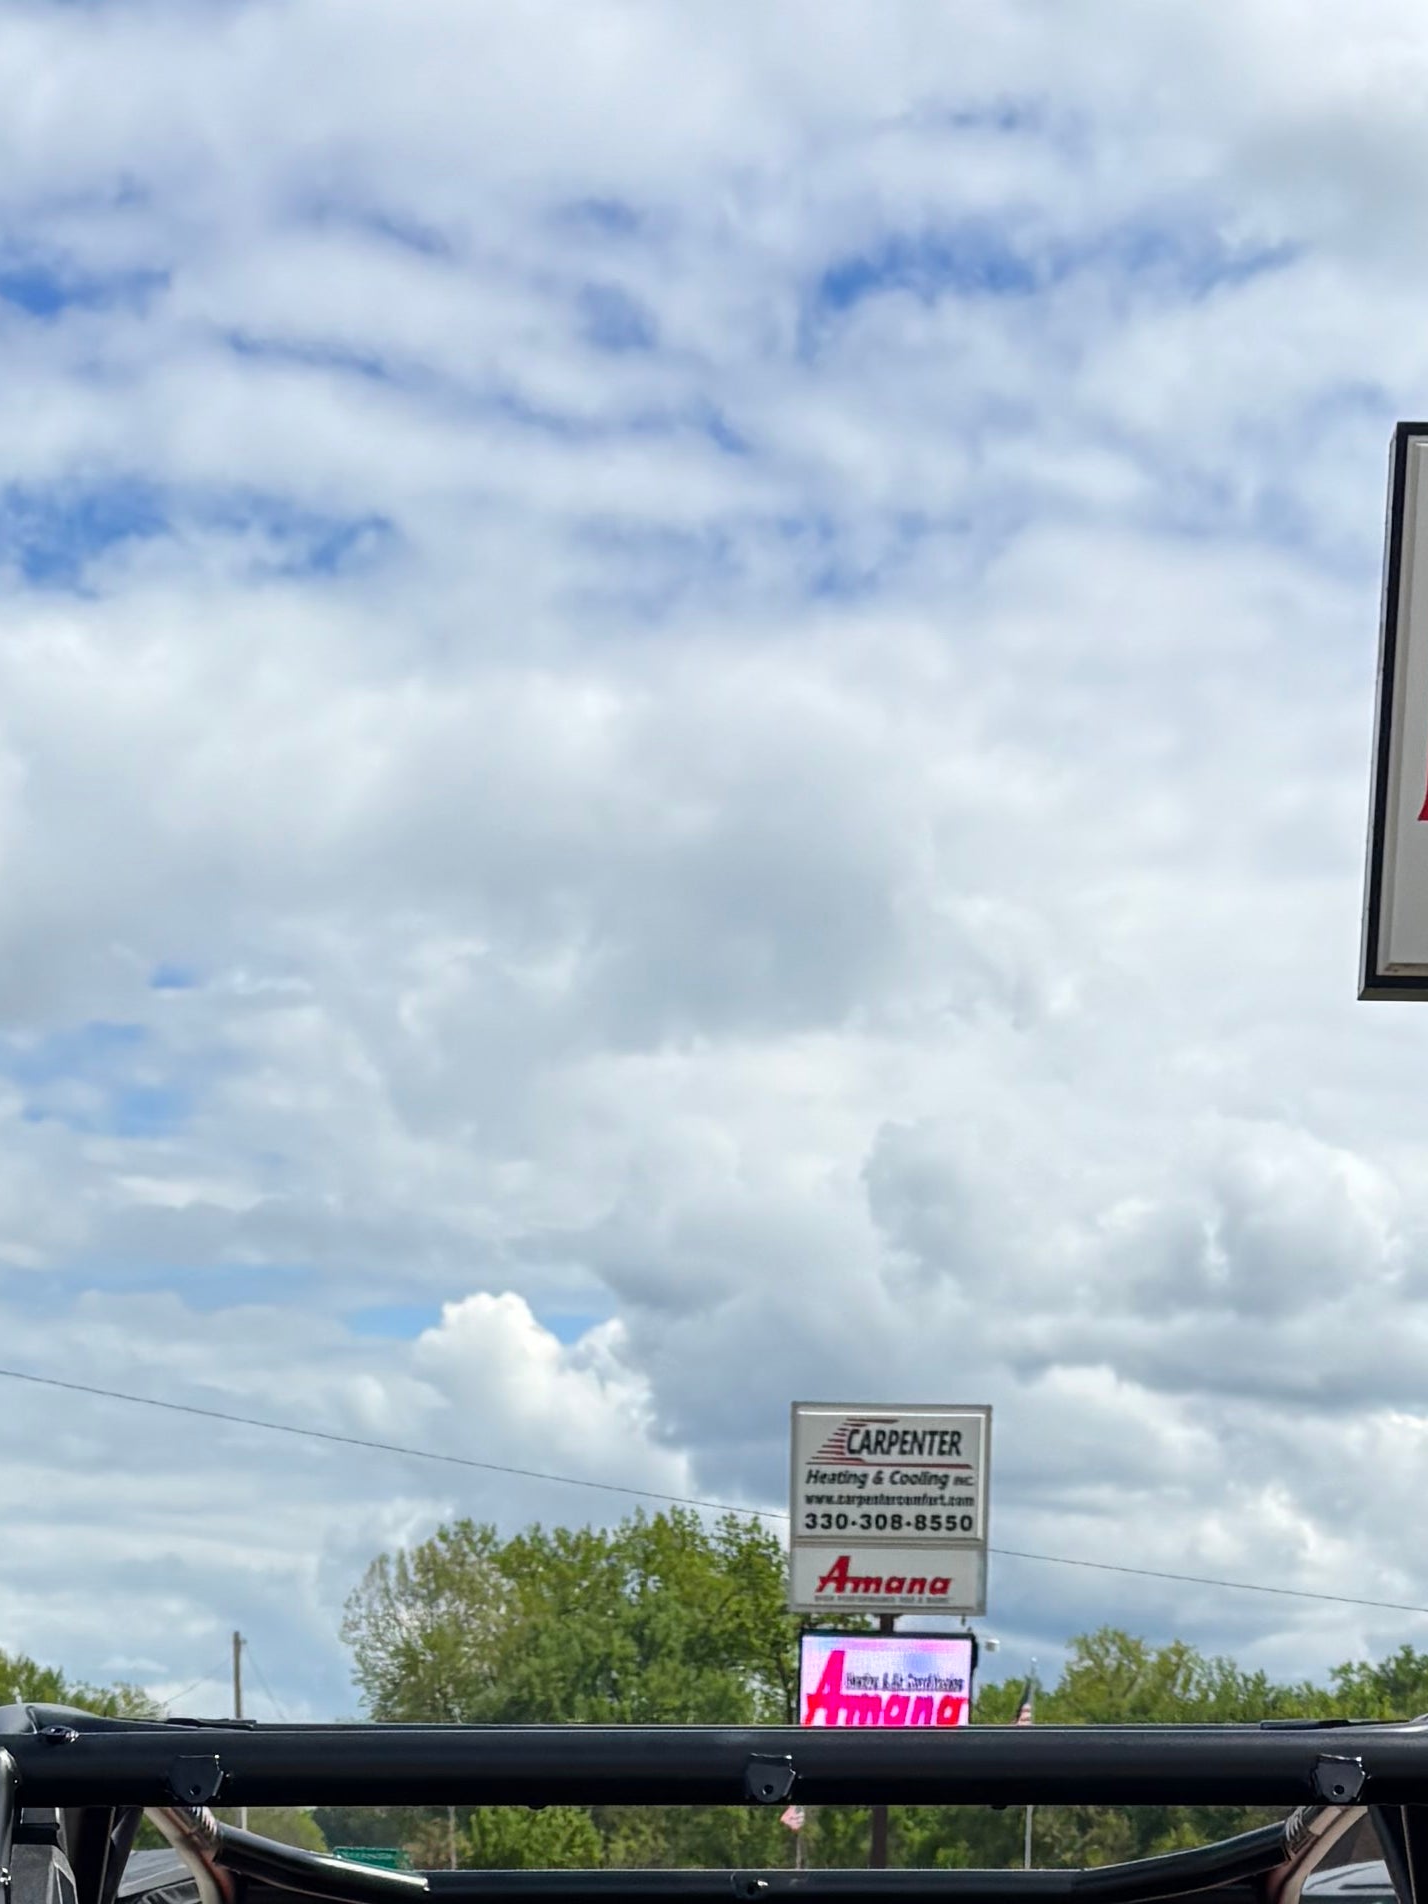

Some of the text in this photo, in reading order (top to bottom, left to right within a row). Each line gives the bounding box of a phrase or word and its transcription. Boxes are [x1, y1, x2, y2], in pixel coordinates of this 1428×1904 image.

[846, 1428, 962, 1457] CARPENTER
[805, 1469, 868, 1489] Heating
[874, 1471, 884, 1485] &
[889, 1470, 949, 1490] Cooling
[815, 1555, 953, 1595] Amana
[803, 1650, 968, 1727] Amana
